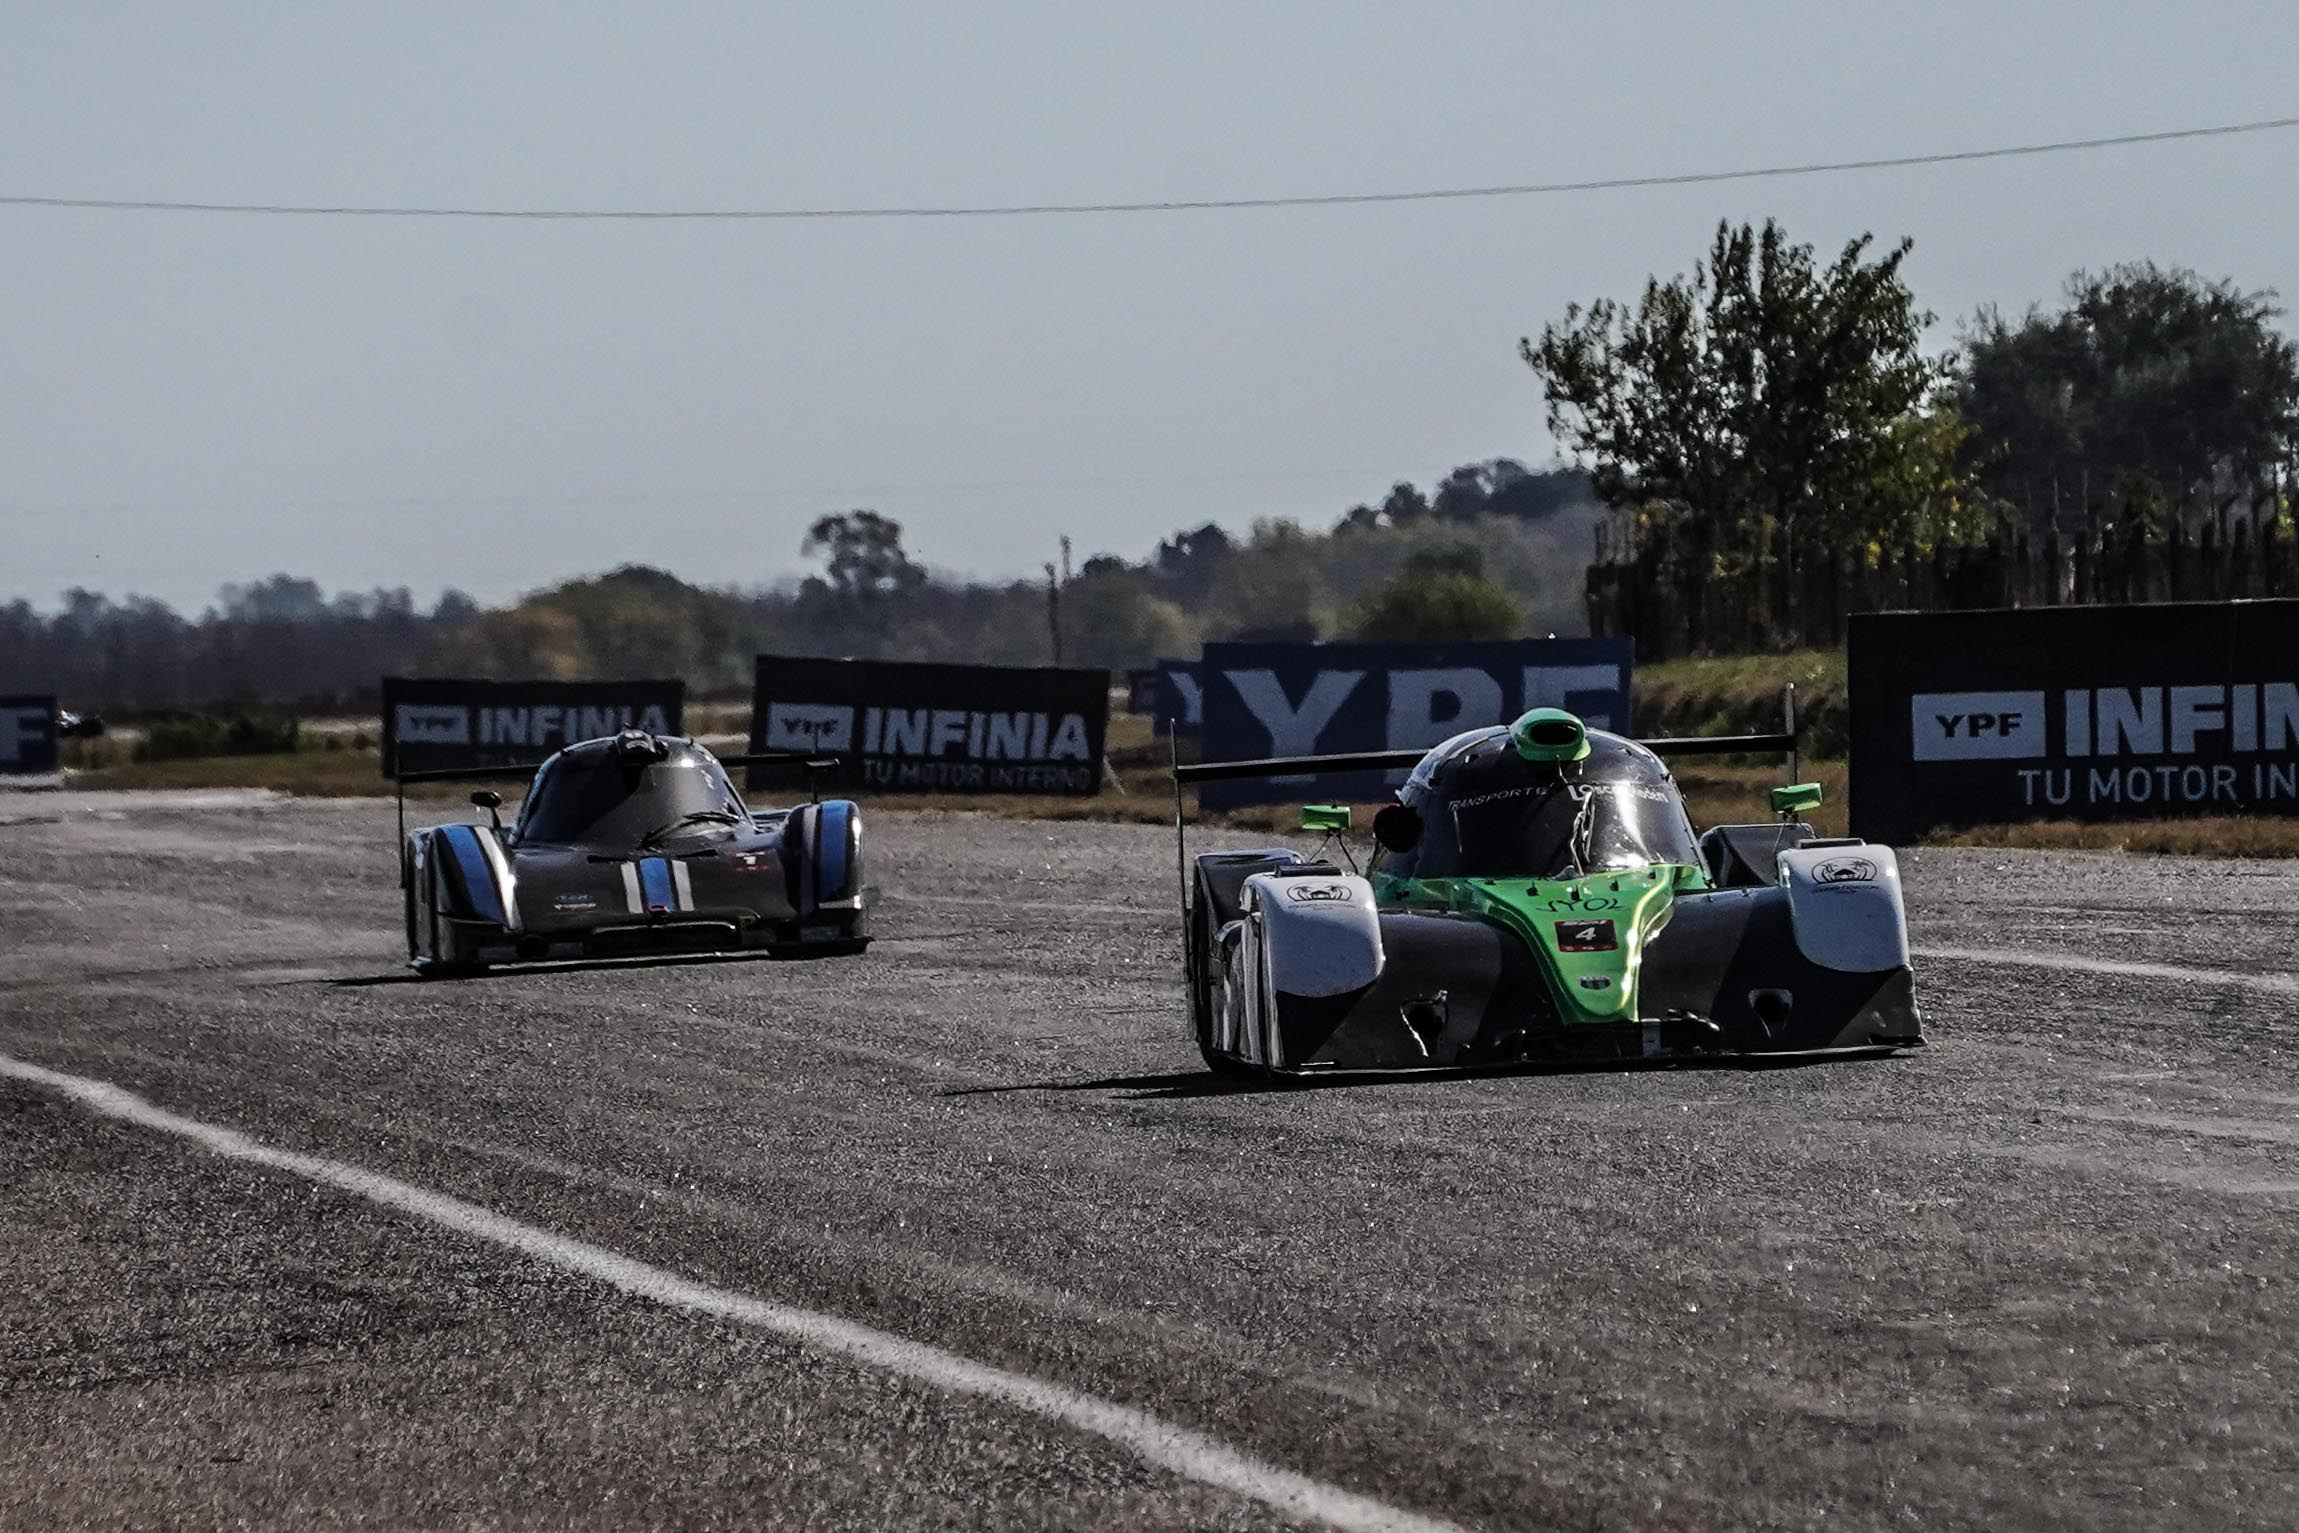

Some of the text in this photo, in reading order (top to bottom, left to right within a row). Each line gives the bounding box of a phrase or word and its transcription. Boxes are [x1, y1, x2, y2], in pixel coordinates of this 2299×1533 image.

[863, 705, 1090, 760] INFINIA
[1935, 712, 2024, 738] YPF
[864, 758, 1091, 791] TU MOTOR INTERNO
[2017, 769, 2071, 805] TU
[2090, 764, 2238, 804] MOTOR
[1575, 927, 1597, 941] 4
